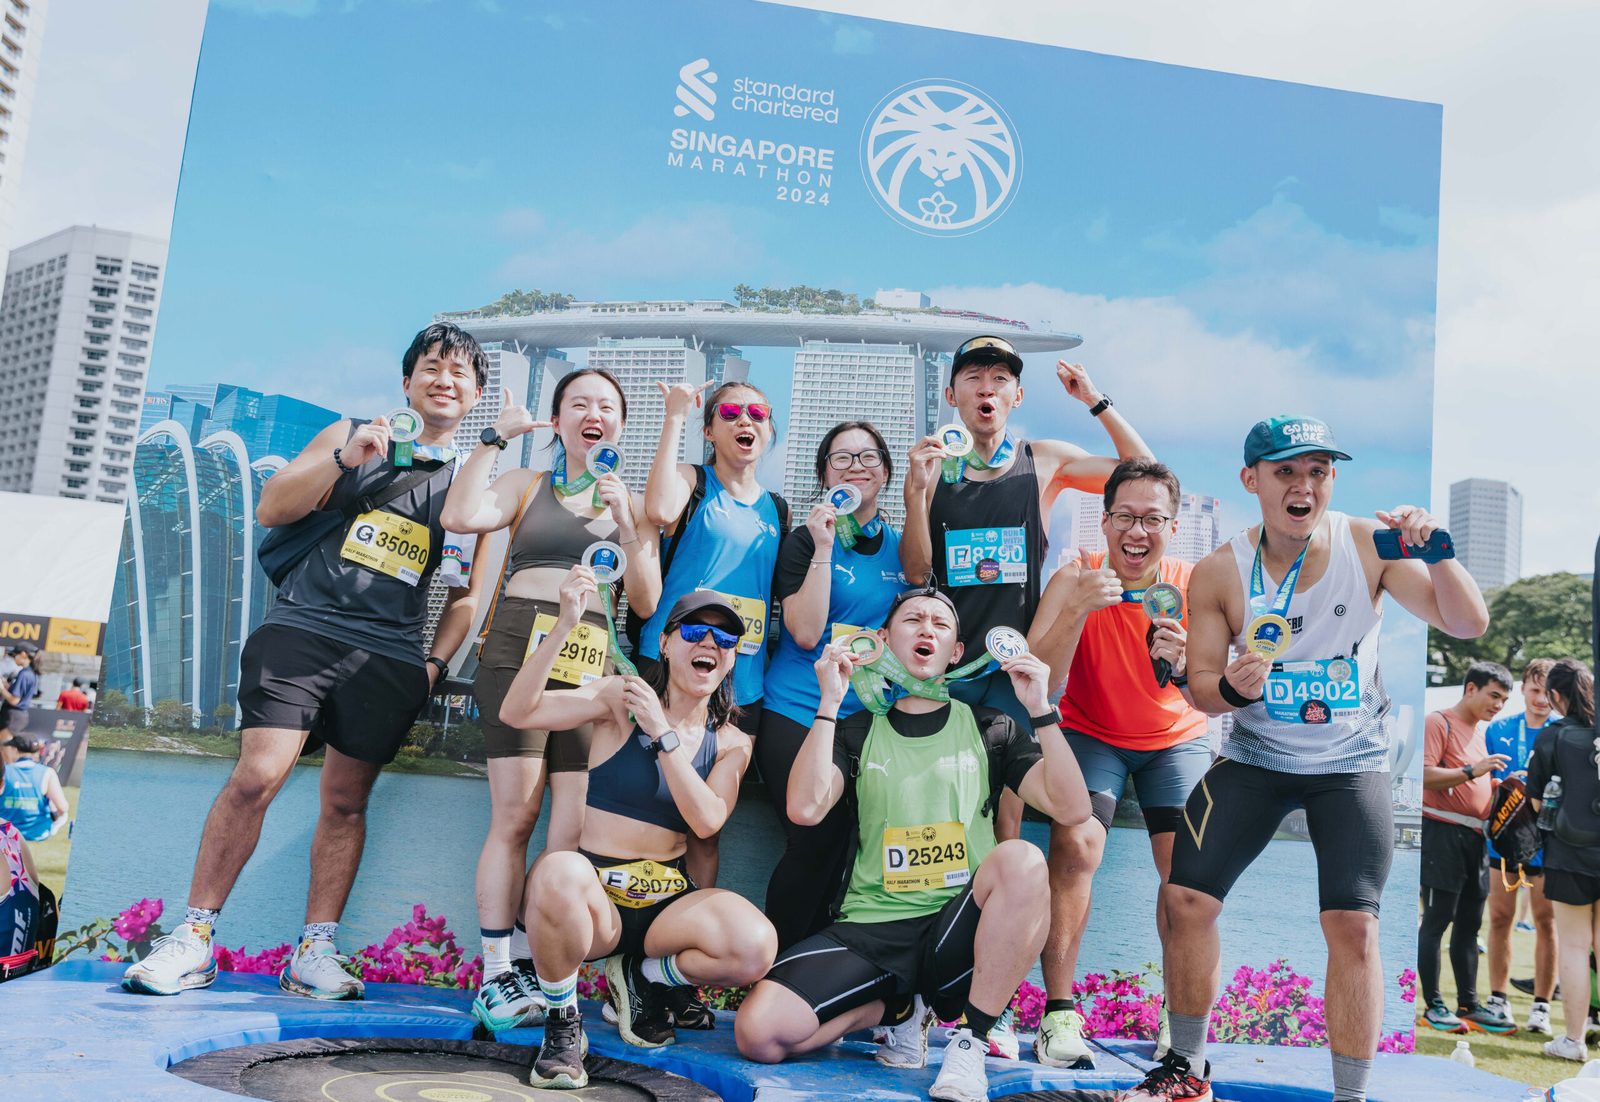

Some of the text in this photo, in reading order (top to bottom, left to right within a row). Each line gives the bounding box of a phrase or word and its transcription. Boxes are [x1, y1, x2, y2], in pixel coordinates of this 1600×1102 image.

[732, 76, 835, 106] standard
[731, 93, 839, 124] chartered
[670, 128, 835, 170] SINGAPORE
[667, 152, 832, 188] MARATHON
[776, 186, 831, 206] 2024
[1282, 422, 1325, 436] GO ONE
[1290, 432, 1325, 445] MORE
[355, 550, 379, 562] MARATHON
[356, 525, 375, 542] G
[375, 531, 428, 565] 35080
[972, 545, 1023, 564] 8790
[559, 641, 604, 667] 29181
[1270, 680, 1357, 701] D 4902
[888, 842, 965, 868] D 25243
[606, 871, 685, 893] E 29079
